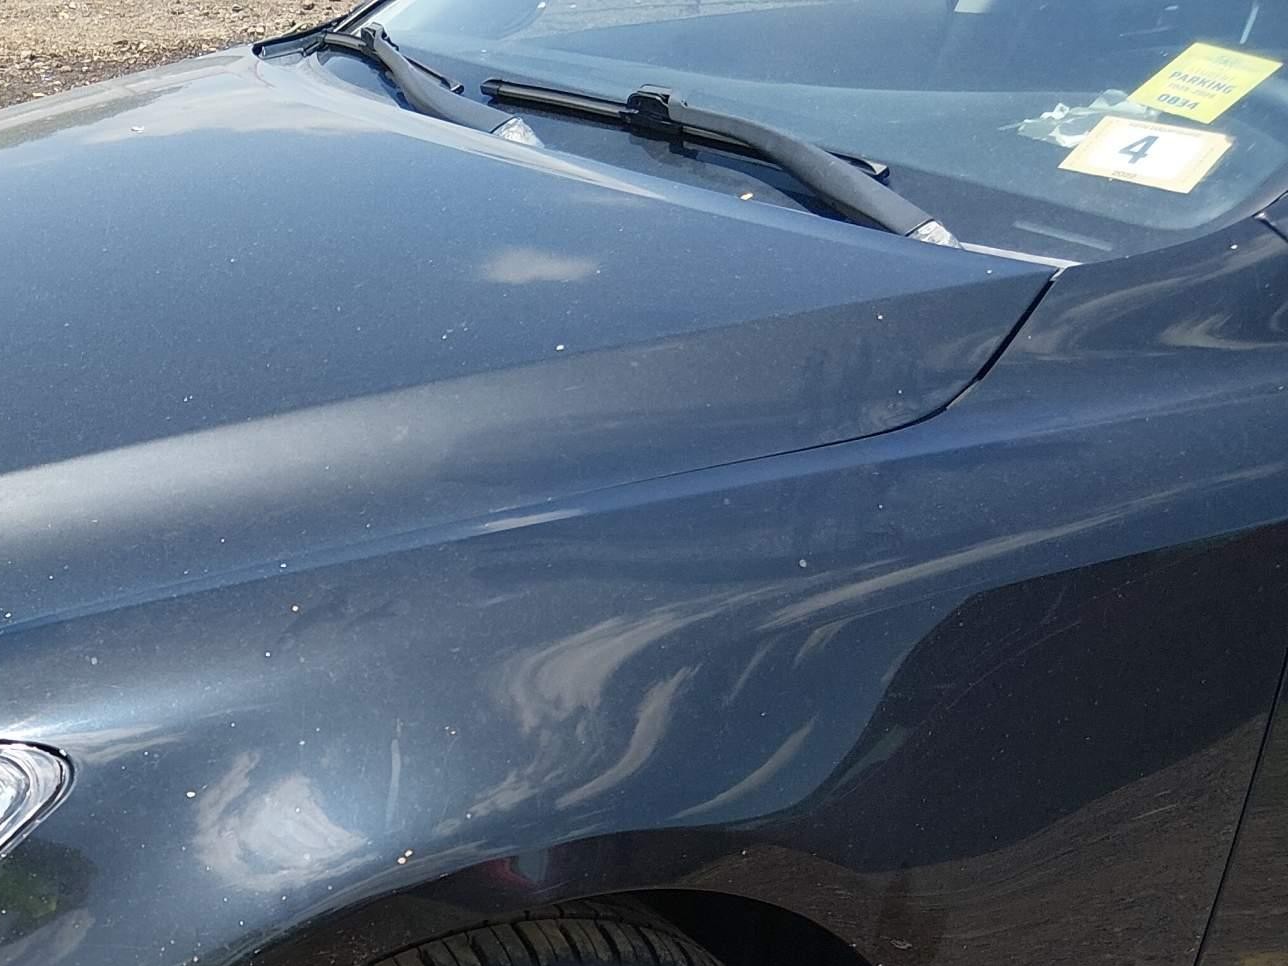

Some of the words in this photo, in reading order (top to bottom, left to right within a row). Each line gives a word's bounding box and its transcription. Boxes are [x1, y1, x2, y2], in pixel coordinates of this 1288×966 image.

[1169, 71, 1235, 94] PARKING
[1157, 93, 1199, 110] 0834
[1117, 135, 1159, 164] 4
